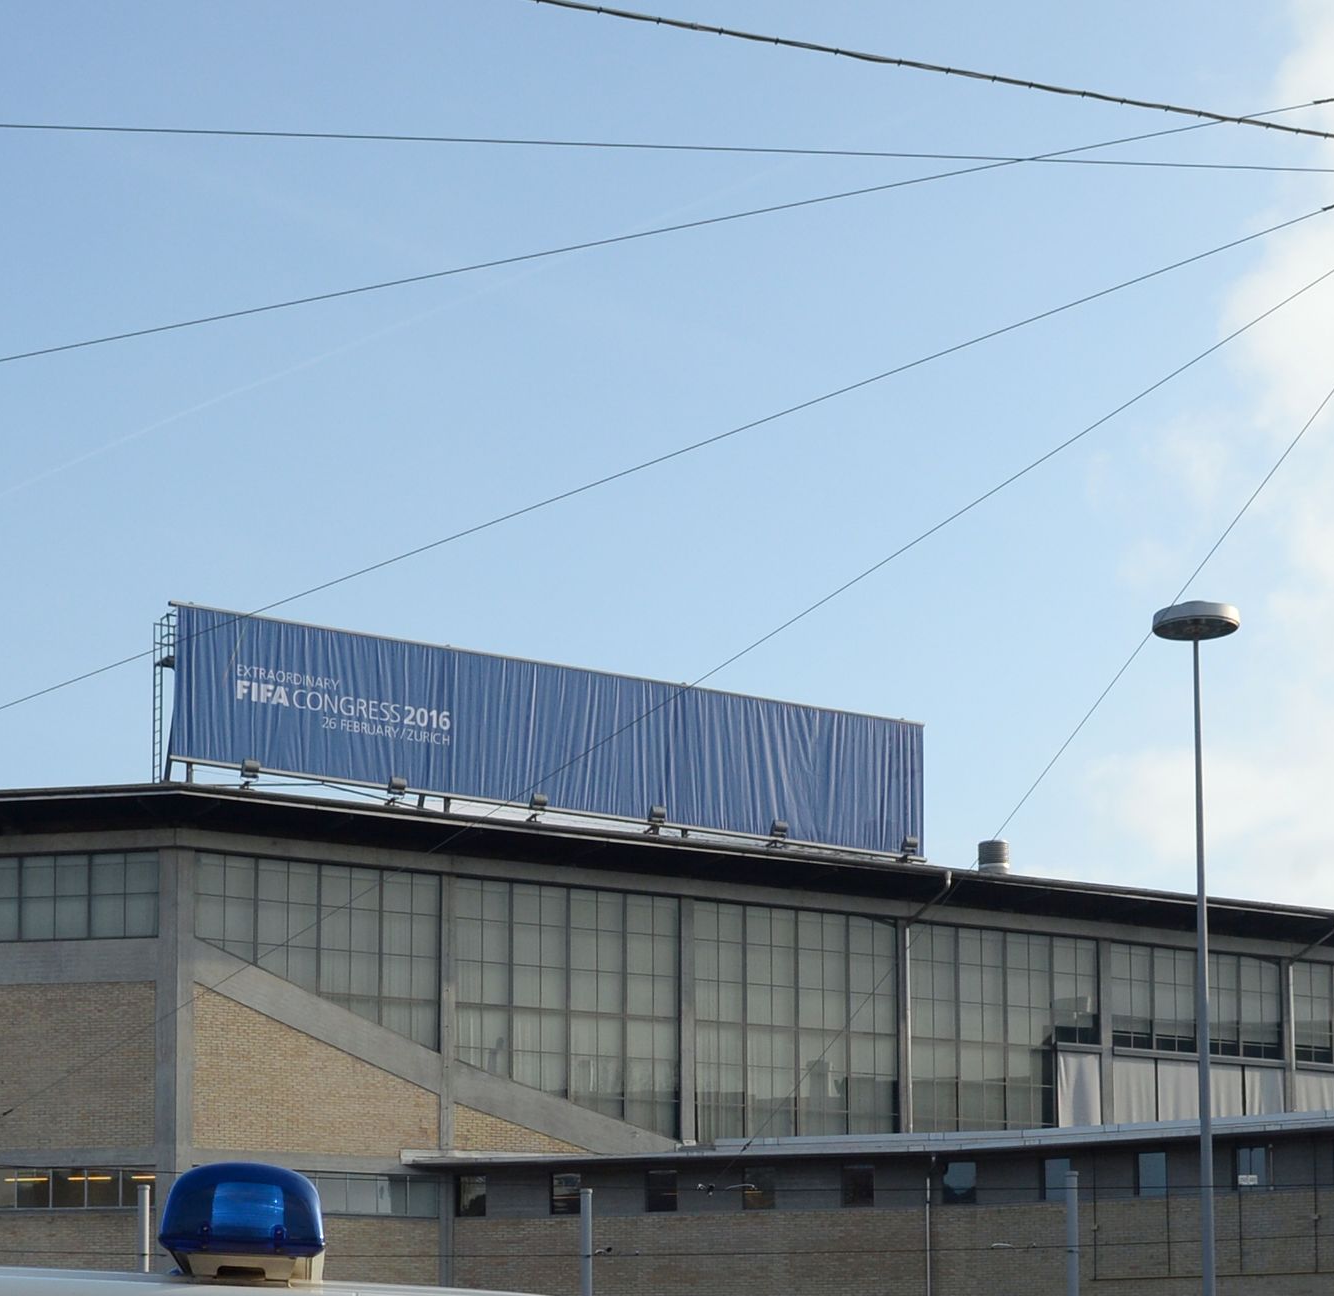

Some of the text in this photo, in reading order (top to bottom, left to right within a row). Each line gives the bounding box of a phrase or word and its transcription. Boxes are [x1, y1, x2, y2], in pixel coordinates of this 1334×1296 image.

[236, 664, 340, 691] EXTRAORDINARY
[236, 680, 450, 730] FIFA CONGRESS 2016
[322, 716, 337, 730] 26
